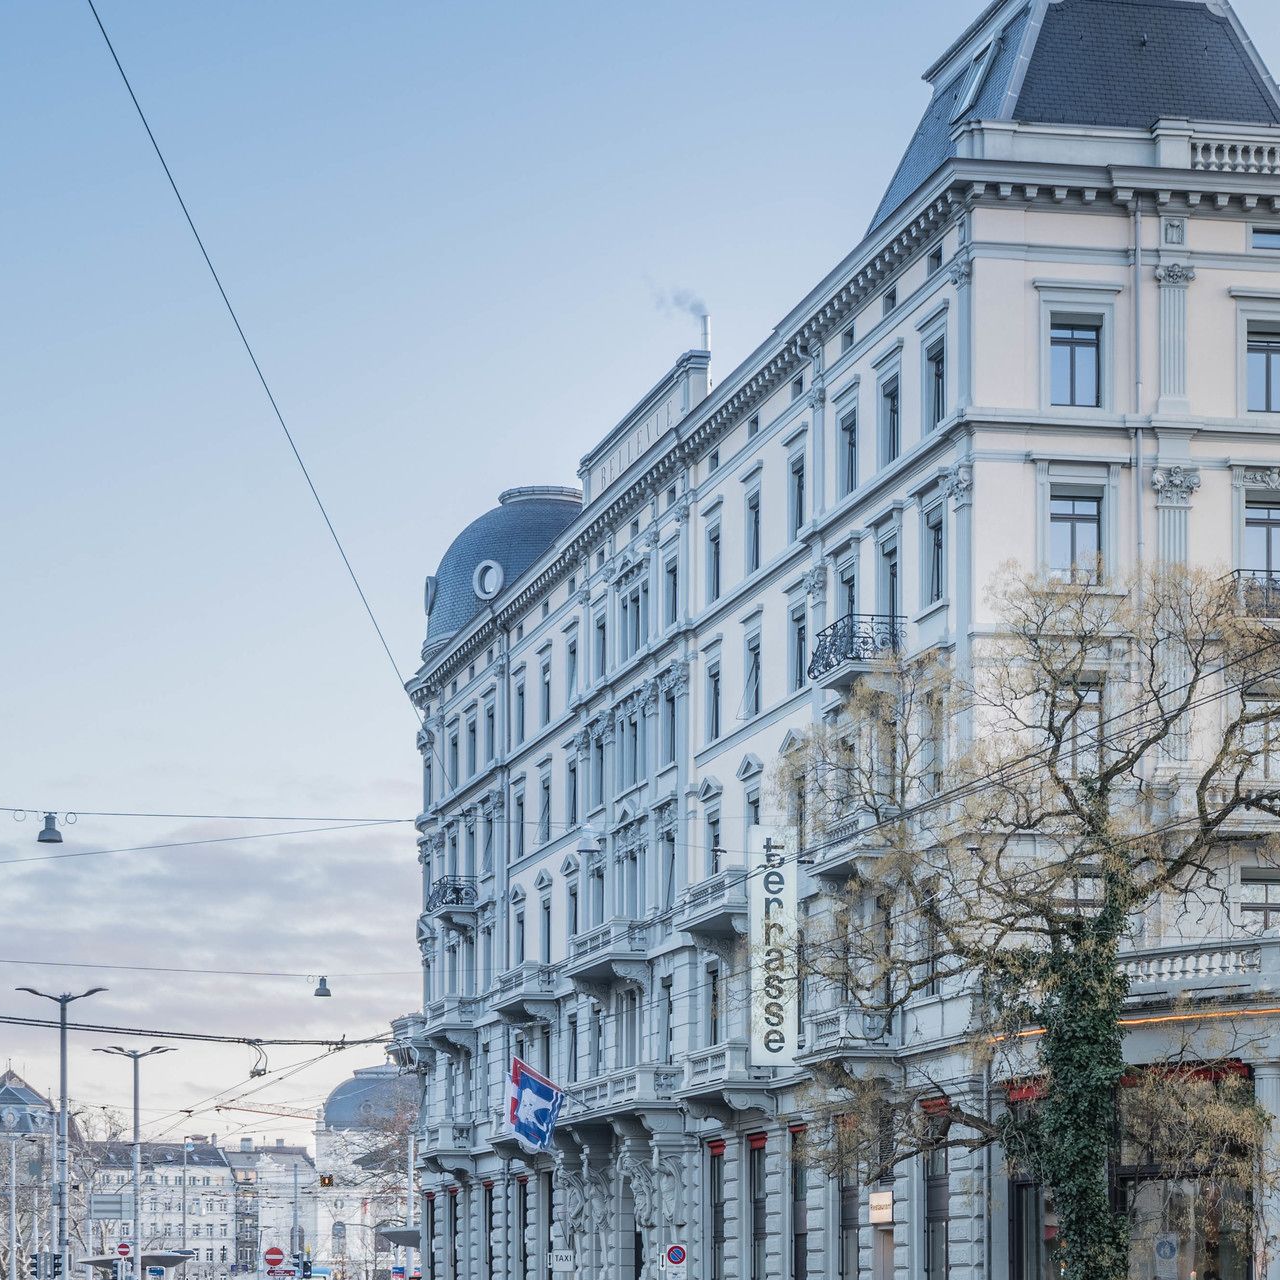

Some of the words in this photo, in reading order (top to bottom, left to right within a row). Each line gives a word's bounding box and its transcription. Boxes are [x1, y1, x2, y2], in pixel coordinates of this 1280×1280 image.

[601, 400, 672, 490] BELLEVUE
[763, 837, 786, 1054] terrasse
[554, 1254, 572, 1262] TAXI
